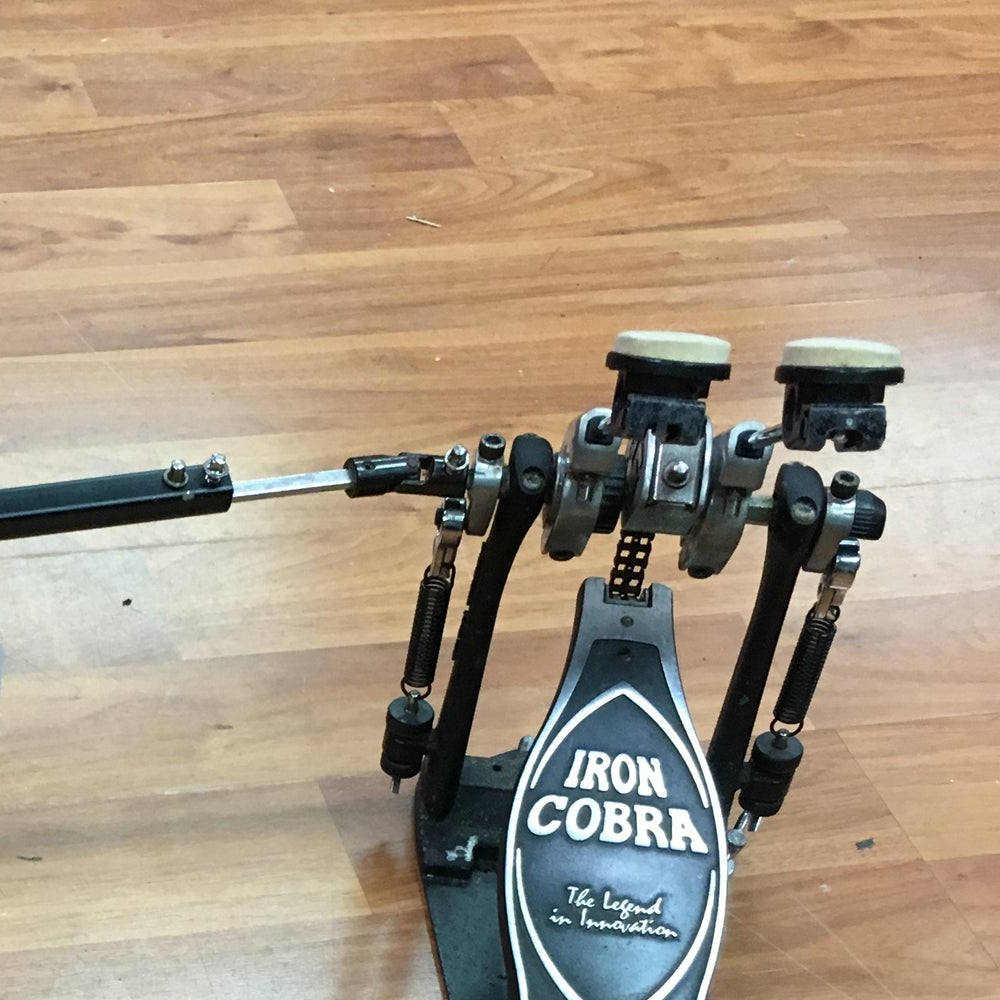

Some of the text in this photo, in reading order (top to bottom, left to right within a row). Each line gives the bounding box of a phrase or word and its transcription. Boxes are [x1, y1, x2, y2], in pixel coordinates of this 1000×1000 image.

[563, 749, 667, 798] IRON
[526, 794, 708, 854] COBRA
[549, 908, 678, 938] in Innovation
[567, 886, 662, 919] The Legend
